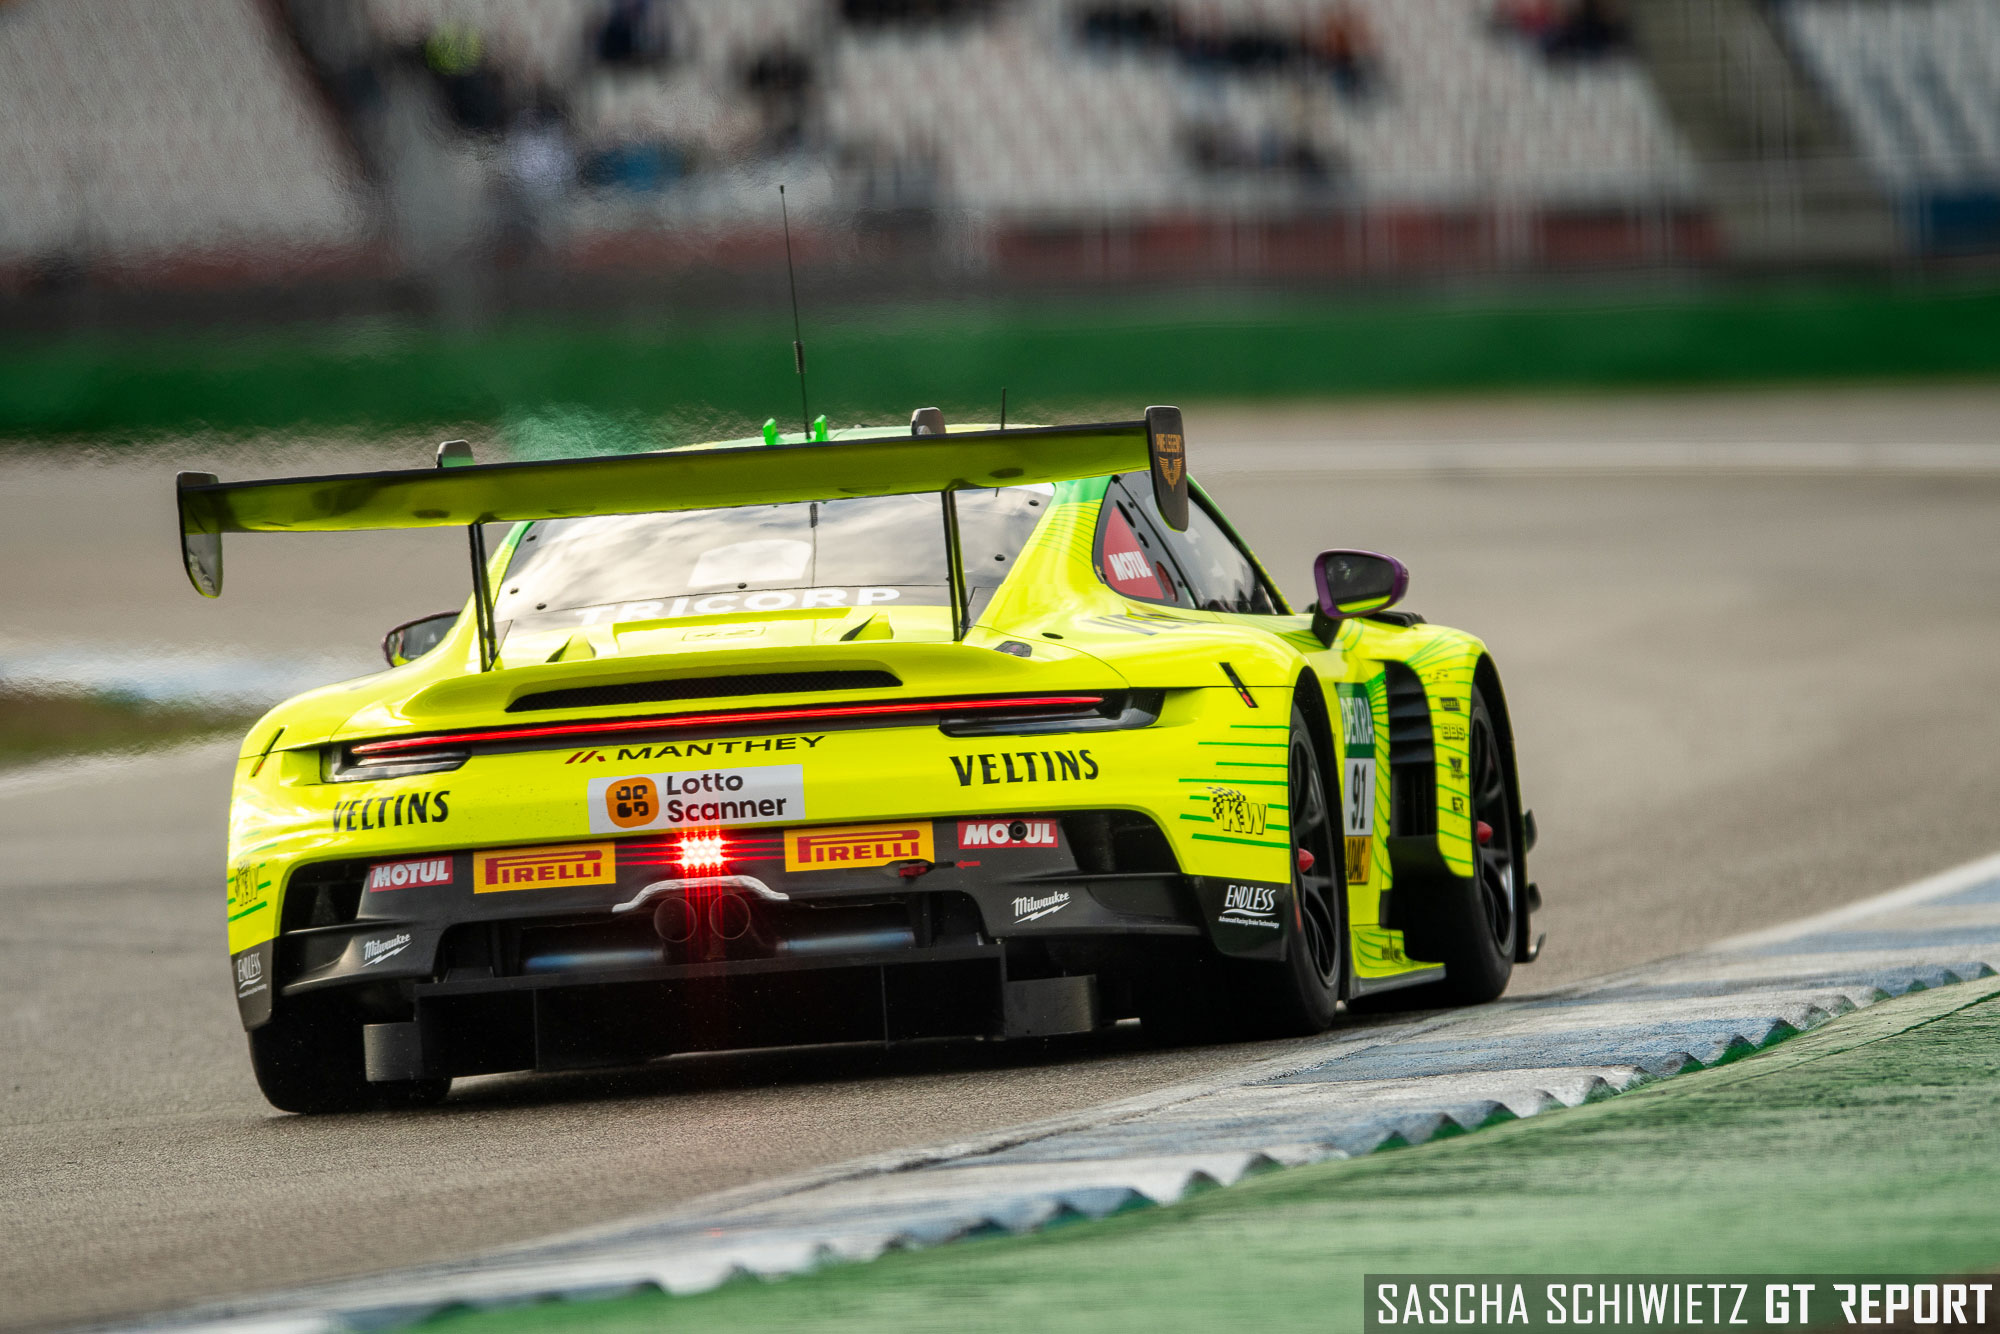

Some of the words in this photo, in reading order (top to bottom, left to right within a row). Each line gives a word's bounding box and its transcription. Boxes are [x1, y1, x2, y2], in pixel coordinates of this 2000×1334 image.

[1108, 551, 1153, 581] MOTUL
[574, 588, 900, 626] TRICORP
[1339, 696, 1376, 745] DEKRA
[1441, 723, 1466, 741] BBS
[617, 735, 826, 761] MANTHEY
[950, 749, 1100, 787] VELTINS
[666, 773, 743, 796] Lotto
[1352, 763, 1367, 830] 91
[333, 790, 451, 833] VELTINS
[667, 796, 787, 823] Scanner
[1222, 799, 1267, 836] KW
[797, 829, 921, 863] PIRELLI
[963, 822, 1055, 845] MOUL
[372, 859, 450, 889] MOTUL
[485, 850, 603, 885] PIRELLI
[1011, 891, 1070, 917] Milwaukee
[1224, 884, 1276, 911] ENDLESS
[364, 932, 412, 961] Milwaukee
